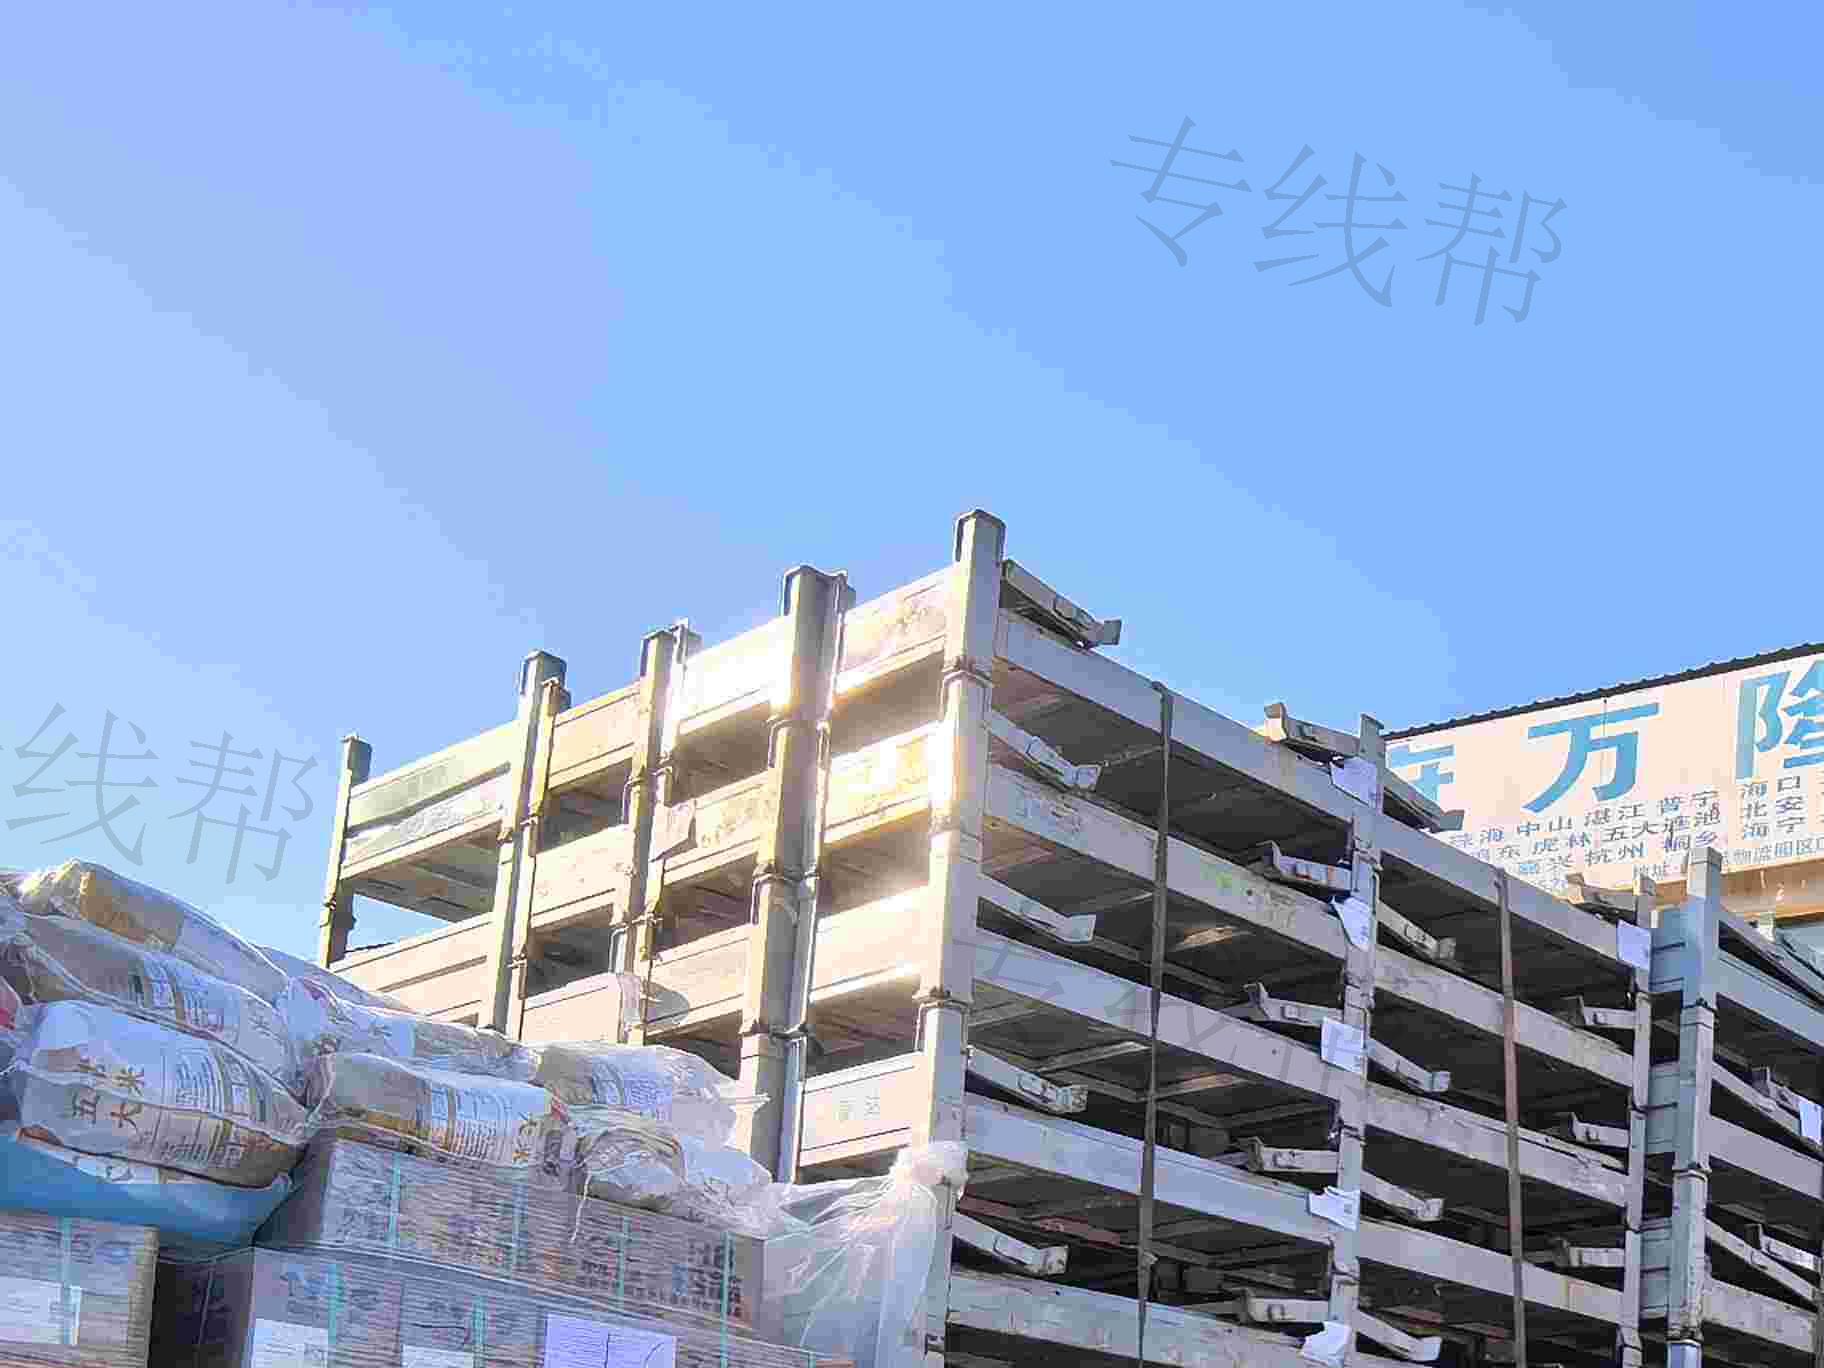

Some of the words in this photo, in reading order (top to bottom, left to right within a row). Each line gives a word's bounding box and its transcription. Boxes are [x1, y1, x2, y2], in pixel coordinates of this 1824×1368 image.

[1517, 818, 1573, 837] 中山
[1584, 803, 1647, 826] 湛江
[1742, 776, 1802, 798] 海口
[1584, 843, 1648, 866] 杭州
